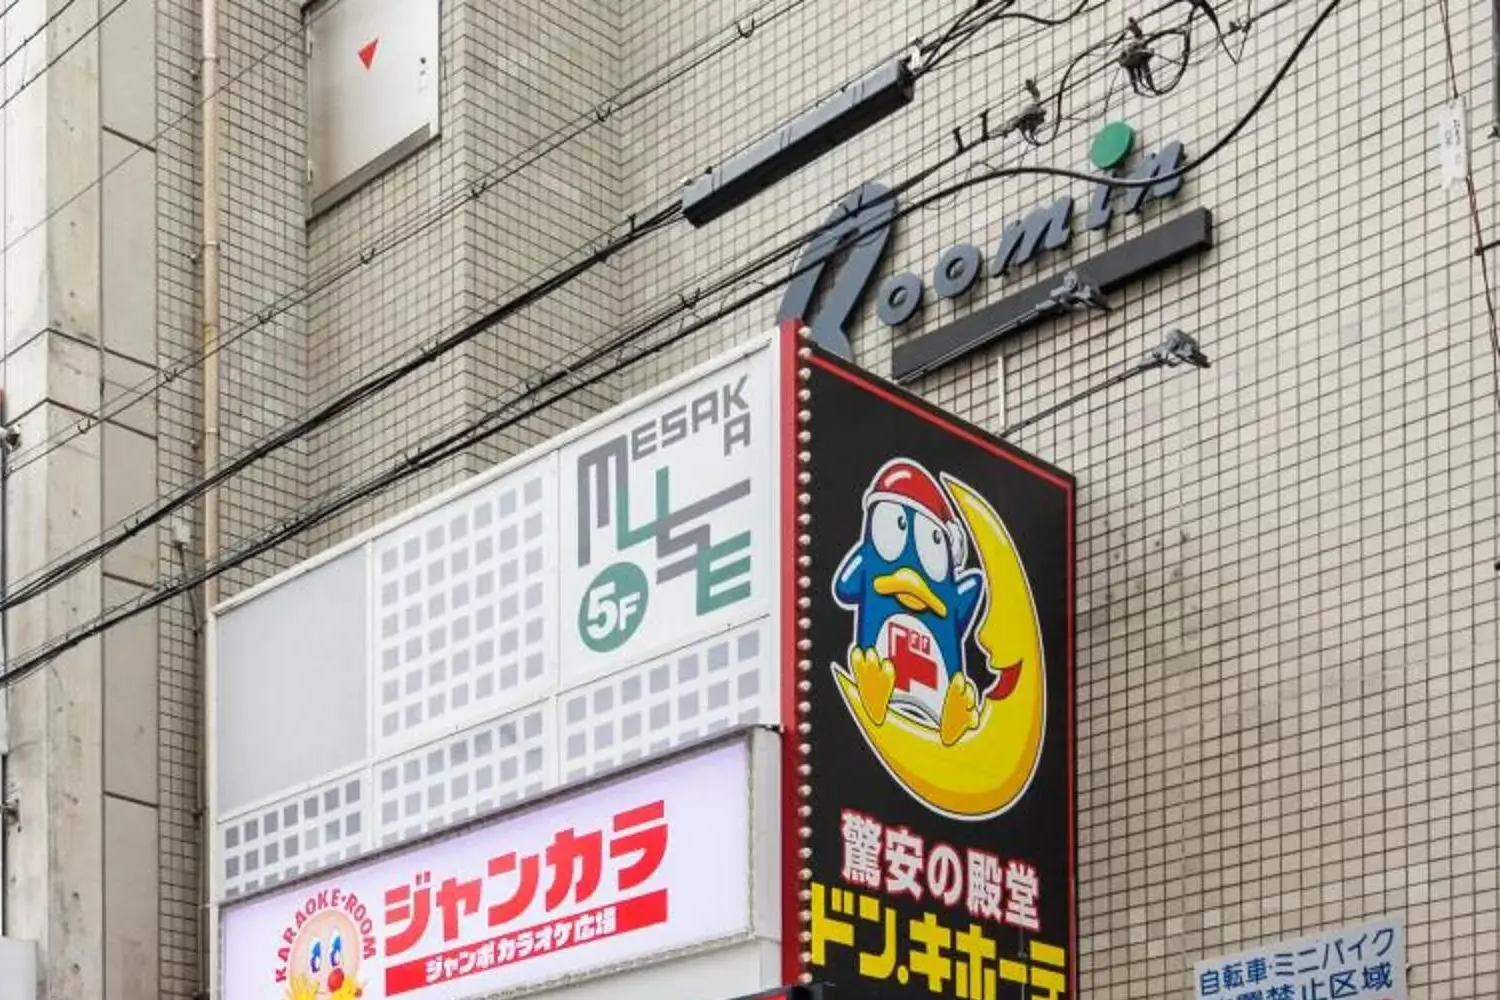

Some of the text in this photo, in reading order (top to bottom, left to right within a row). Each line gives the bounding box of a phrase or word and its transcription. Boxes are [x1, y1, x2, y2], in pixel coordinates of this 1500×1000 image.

[586, 580, 641, 640] 5F
[385, 800, 669, 957] ジャンカラ
[841, 809, 1040, 931] 驚安の殿堂
[425, 906, 617, 985] ジャンボカラオケ広場
